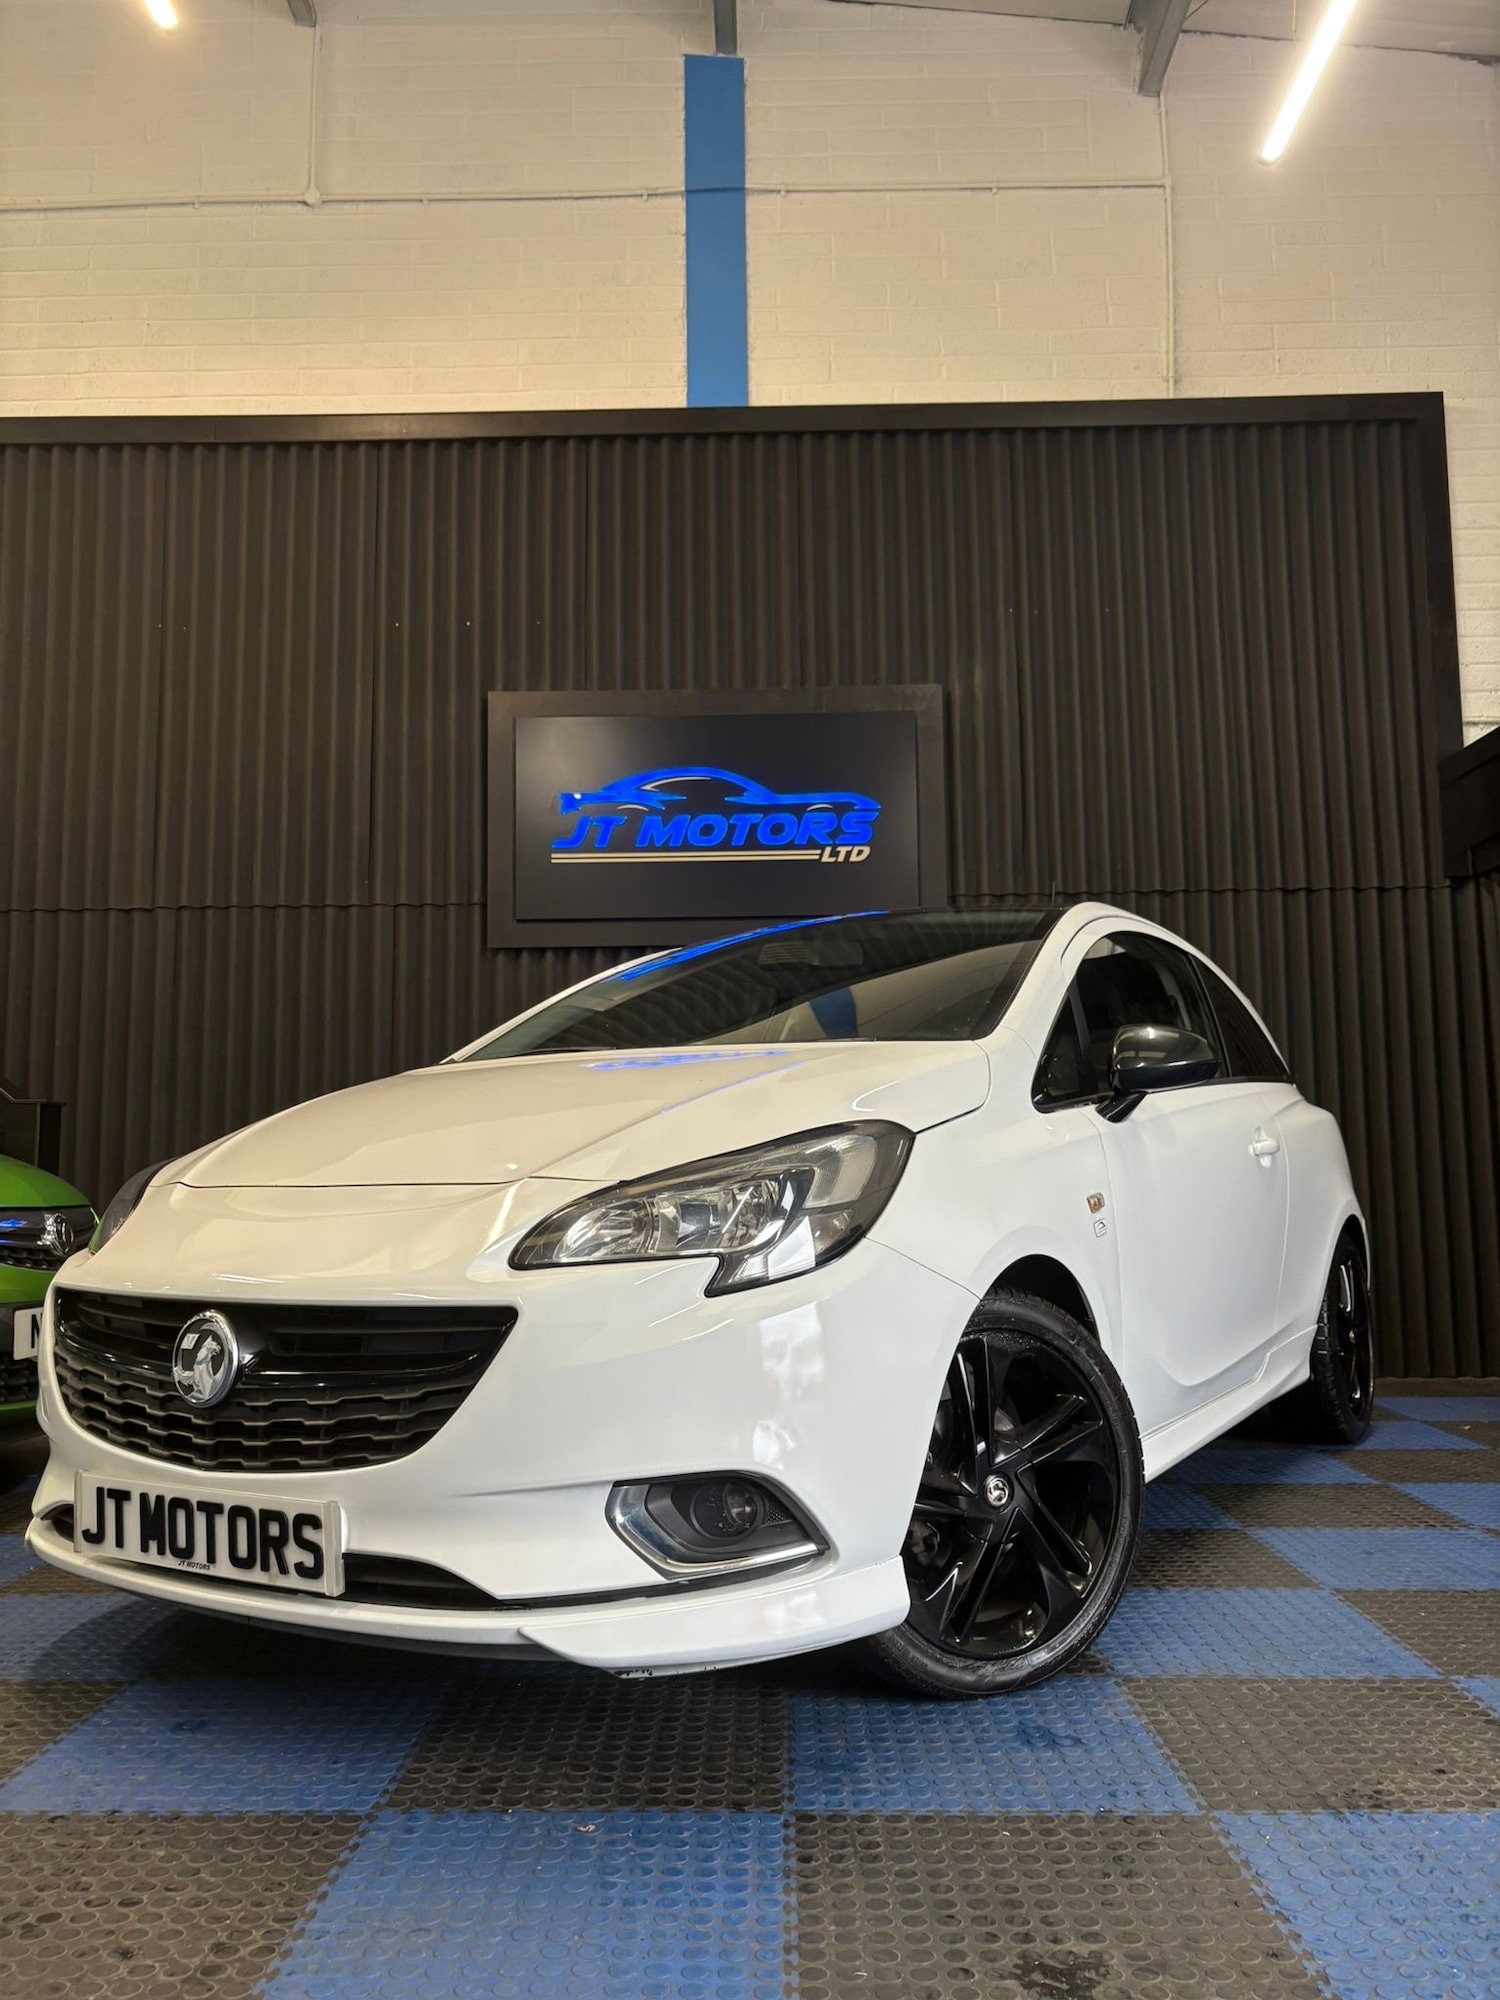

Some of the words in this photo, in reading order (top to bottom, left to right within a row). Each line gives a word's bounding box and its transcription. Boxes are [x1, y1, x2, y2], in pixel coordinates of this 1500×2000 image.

[551, 815, 628, 848] JT
[635, 811, 880, 847] MOTORS
[821, 845, 871, 863] LTD
[81, 1486, 131, 1549] JT
[139, 1492, 325, 1580] MOTORS
[186, 1561, 211, 1571] MOTORS
